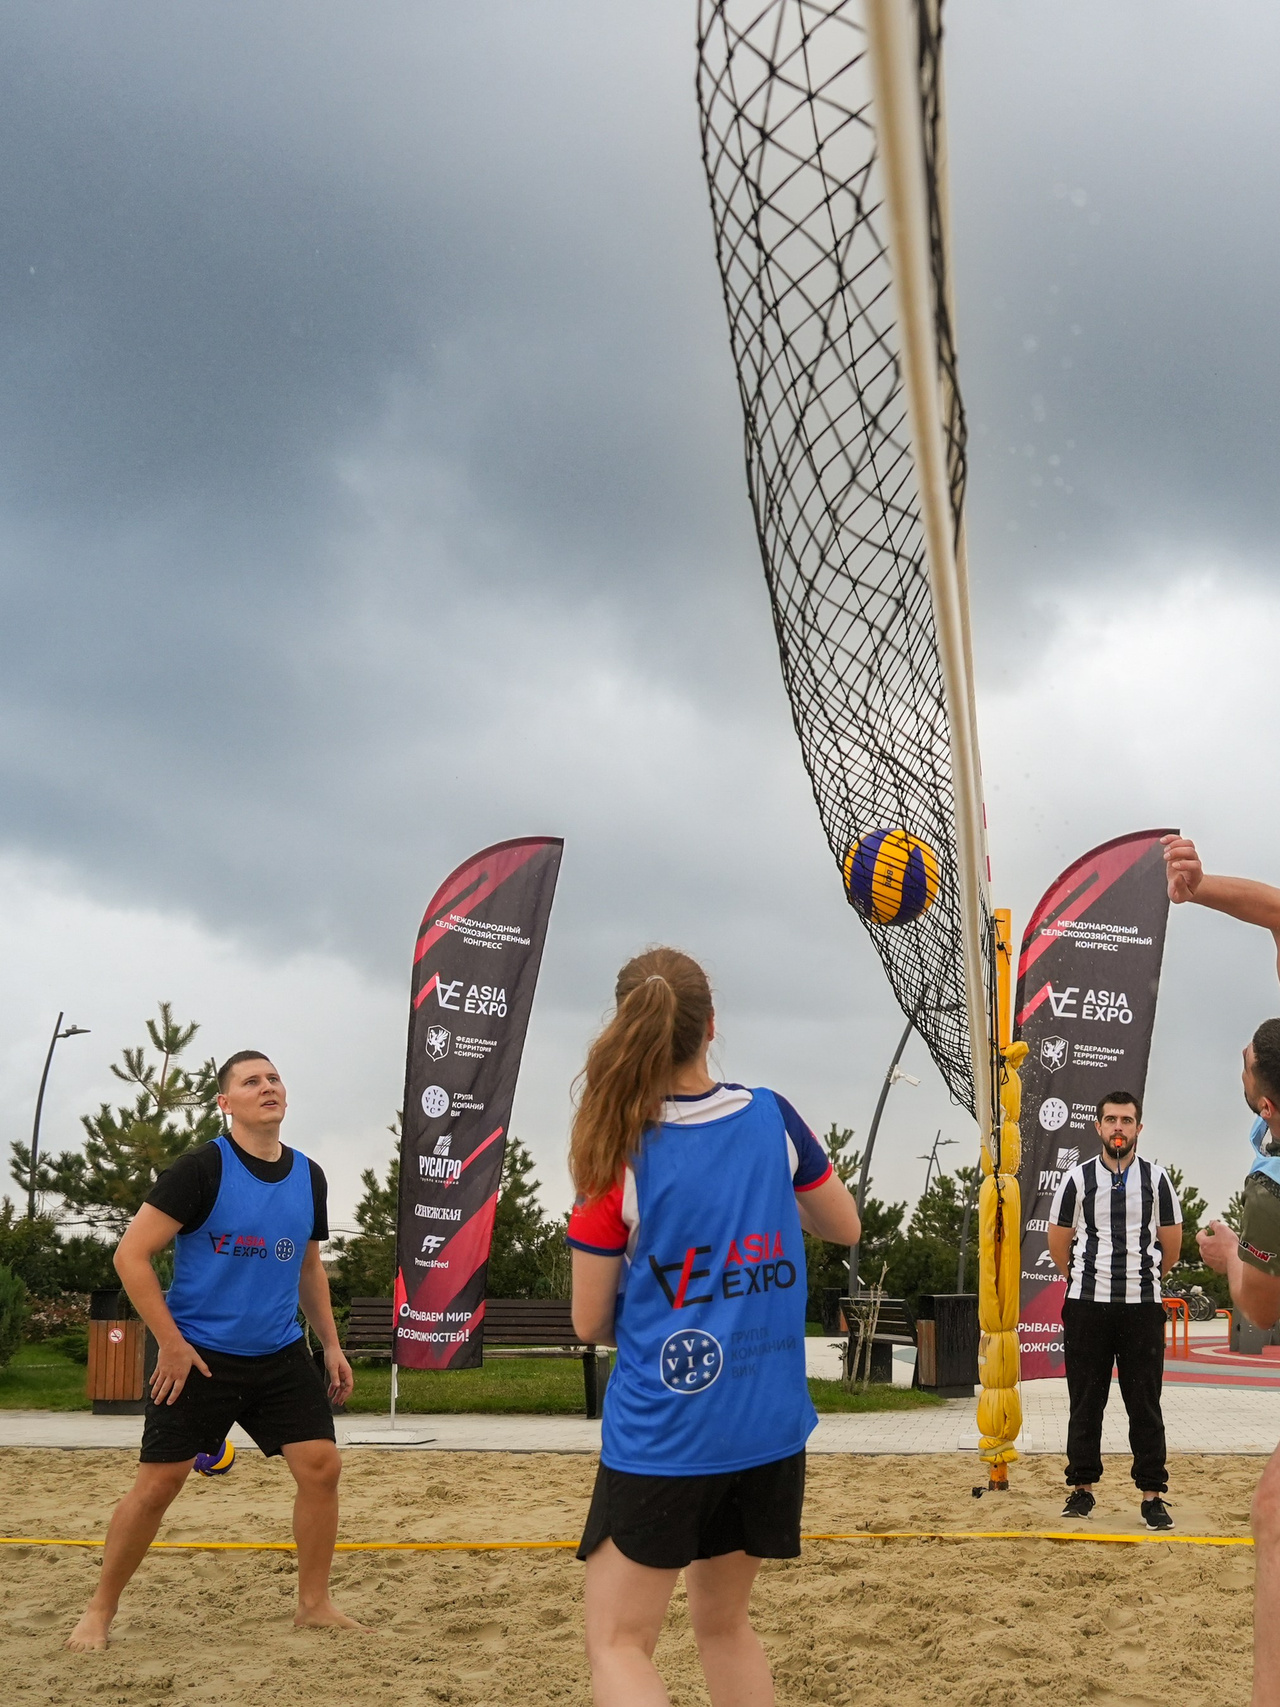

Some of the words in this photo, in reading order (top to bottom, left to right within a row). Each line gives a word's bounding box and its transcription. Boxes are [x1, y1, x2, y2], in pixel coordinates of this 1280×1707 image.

[450, 913, 521, 934] МЕЖДУНАРОДНЫЙ
[1057, 920, 1139, 934] МЕЖДУНАРОДНЫЙ
[435, 919, 530, 946] СЕЛЬСКОХОЗЯЙСТВЕННЫЙ
[1041, 928, 1152, 945] СЕЛЬСКОХОЗЯЙСТВЕННЫЙ
[463, 937, 502, 950] КОНГРЕСС
[1075, 941, 1119, 951] КОНГРЕСС
[466, 984, 506, 1003] ASIA
[1083, 989, 1129, 1008] ASIA
[464, 999, 508, 1018] EXPO
[1081, 1005, 1133, 1025] EXPO
[1073, 1044, 1125, 1055] ФЕДЕРАЛЬНАЯ
[1073, 1051, 1118, 1062] ТЕРРИТОРИЯ
[1072, 1059, 1108, 1068] «СИРИУС»
[1069, 1121, 1086, 1130] ВИК
[419, 1155, 463, 1179] РУСАГРО
[1038, 1170, 1066, 1191] РУС
[234, 1235, 266, 1247] ASIA
[723, 1230, 785, 1269] ASIA
[233, 1246, 268, 1259] EXPO
[722, 1259, 797, 1300] EXPO
[446, 1312, 472, 1322] МИР
